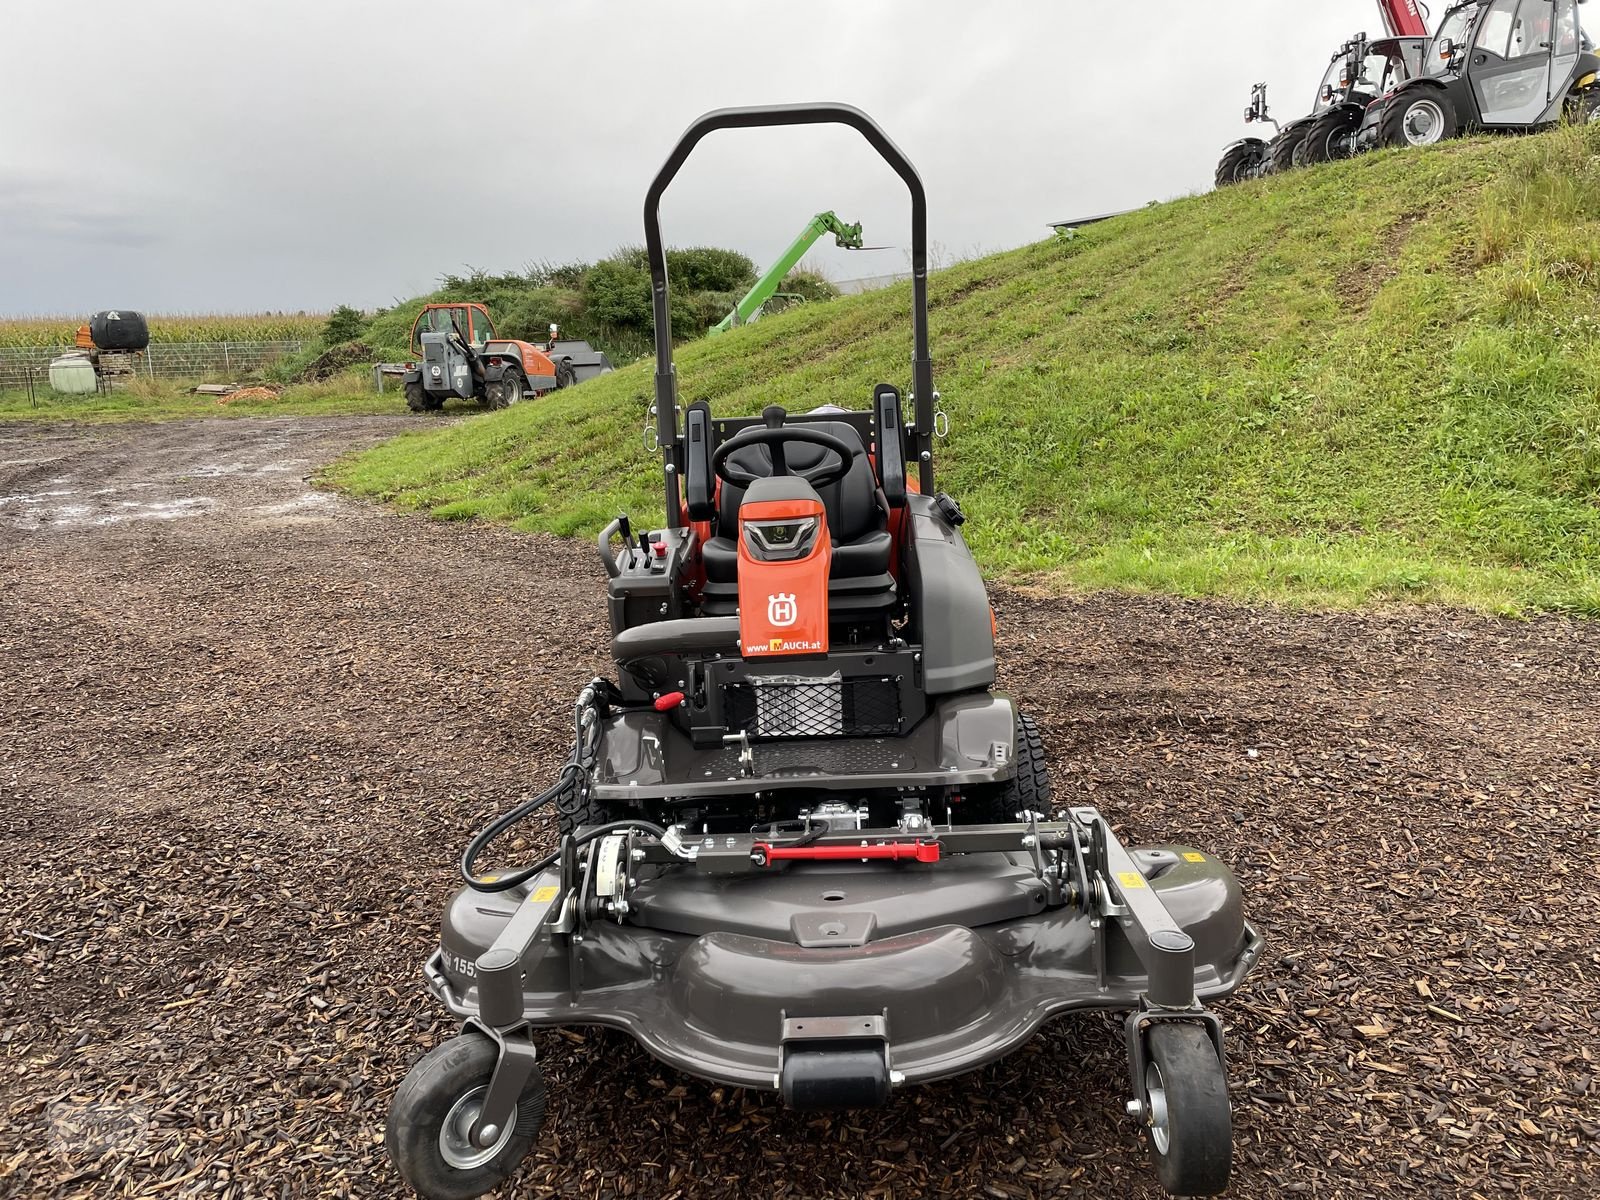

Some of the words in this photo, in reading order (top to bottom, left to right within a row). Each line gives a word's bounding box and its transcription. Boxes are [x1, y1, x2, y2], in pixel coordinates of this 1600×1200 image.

[746, 645, 768, 653] www
[773, 640, 821, 651] MAUCH.at
[453, 957, 477, 978] 155
